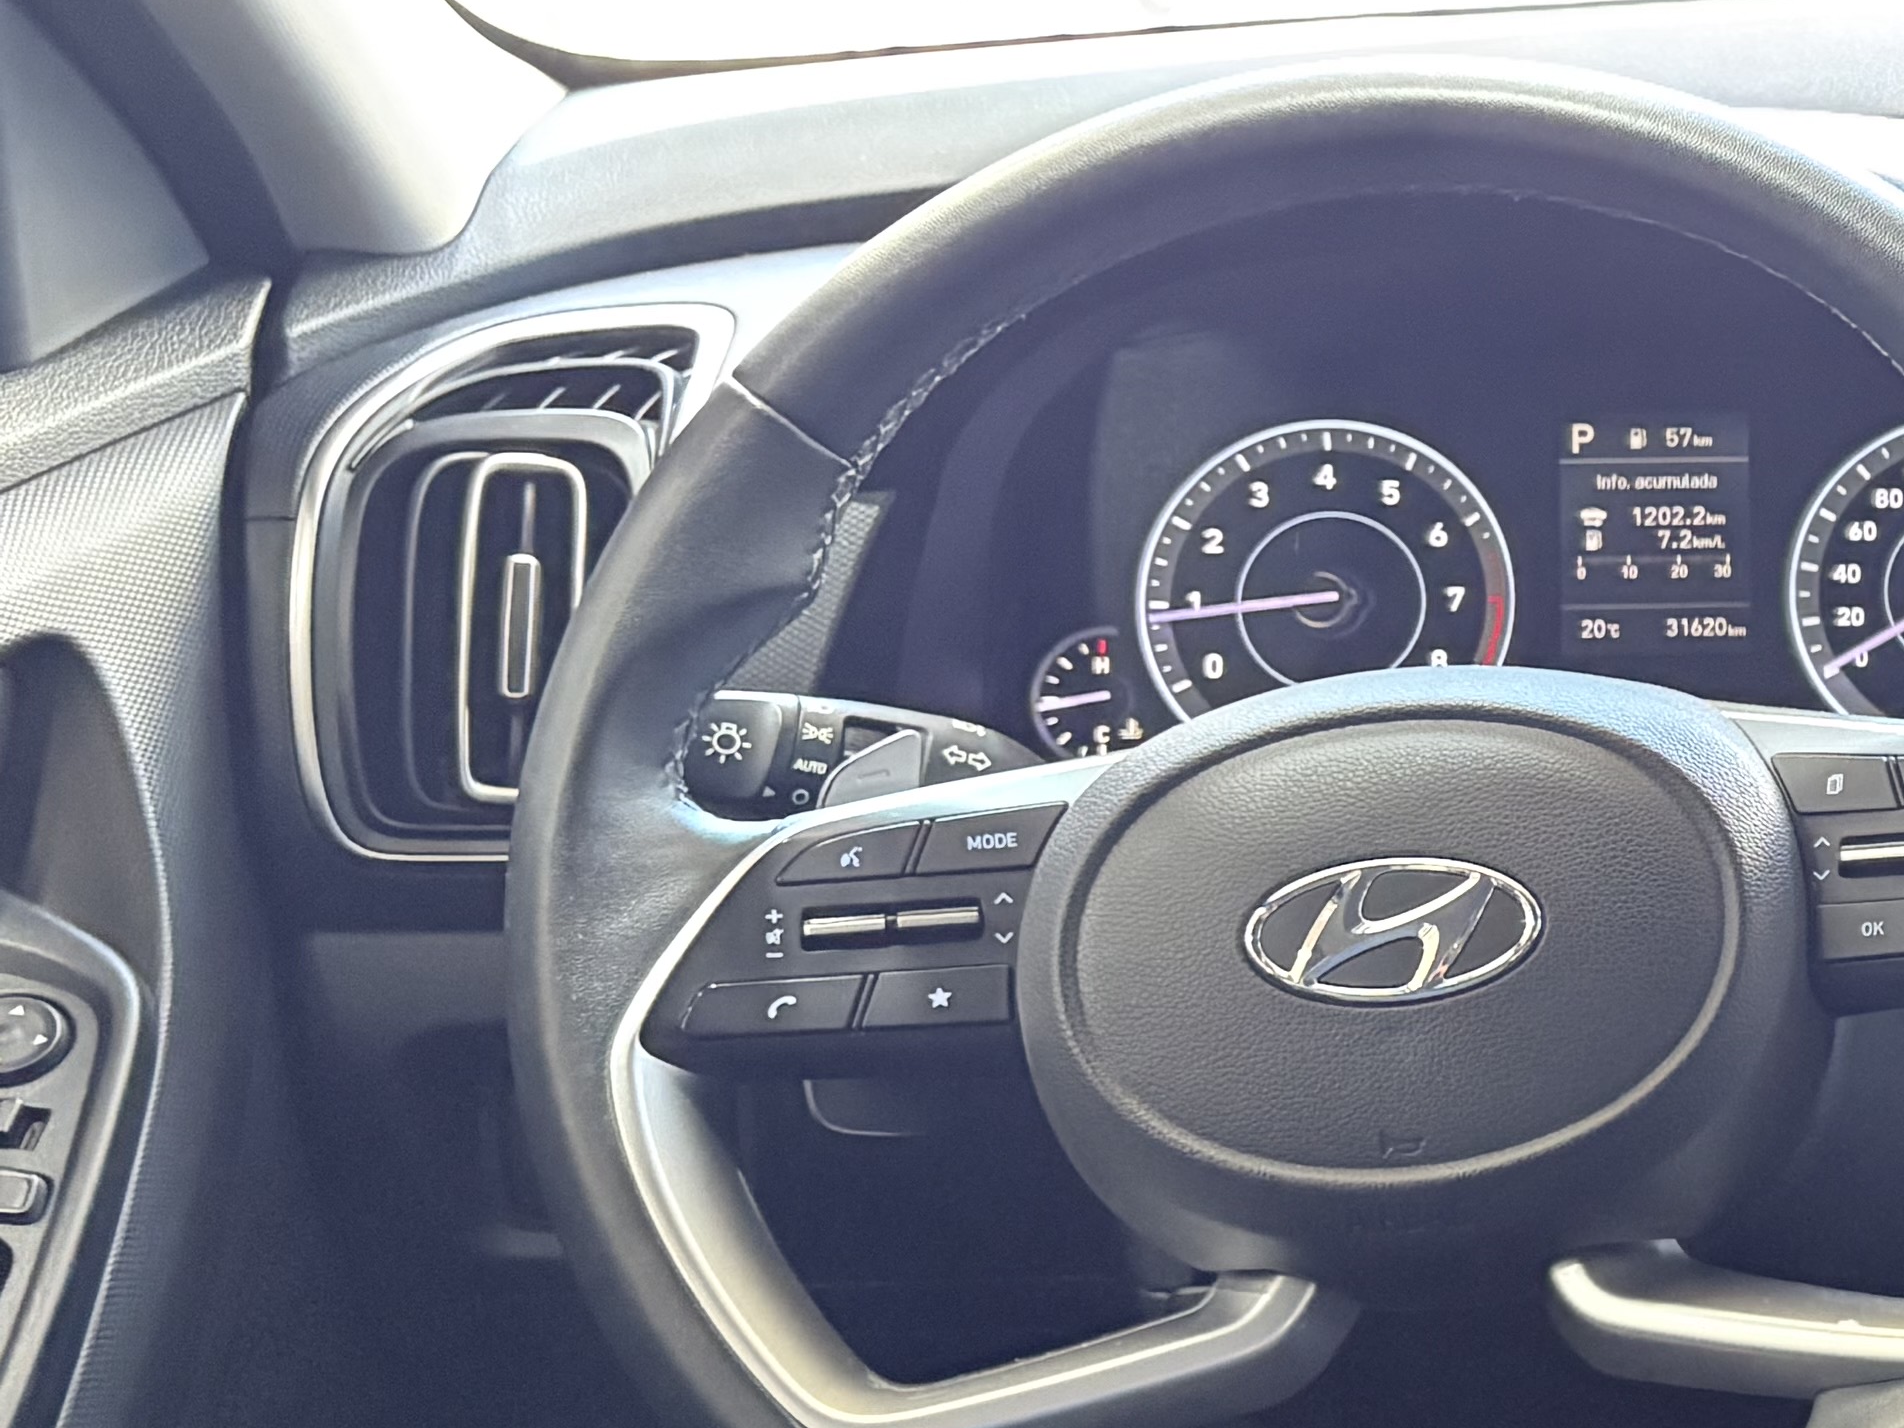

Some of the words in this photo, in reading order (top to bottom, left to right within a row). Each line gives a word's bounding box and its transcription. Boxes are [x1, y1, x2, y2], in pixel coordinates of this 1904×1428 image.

[1571, 423, 1595, 455] P
[1312, 463, 1338, 490] 4
[1635, 473, 1718, 490] acumulada
[1248, 481, 1270, 509] 3
[1380, 480, 1401, 506] 5
[1873, 488, 1904, 509] 80
[1201, 528, 1225, 555] 2
[1427, 522, 1449, 548] 6
[1847, 521, 1877, 542] 60
[1576, 566, 1587, 581] 0
[1621, 564, 1639, 580] 10
[1671, 564, 1689, 580] 20
[1713, 564, 1732, 579] 30
[1832, 564, 1862, 584] 40
[1186, 591, 1202, 612] 1
[1445, 587, 1467, 613] 7
[1835, 606, 1865, 627] 20
[1201, 654, 1224, 680] 0
[1092, 725, 1110, 744] C
[793, 758, 828, 775] AUTO
[966, 830, 1018, 853] MODE
[1861, 921, 1885, 936] OK
